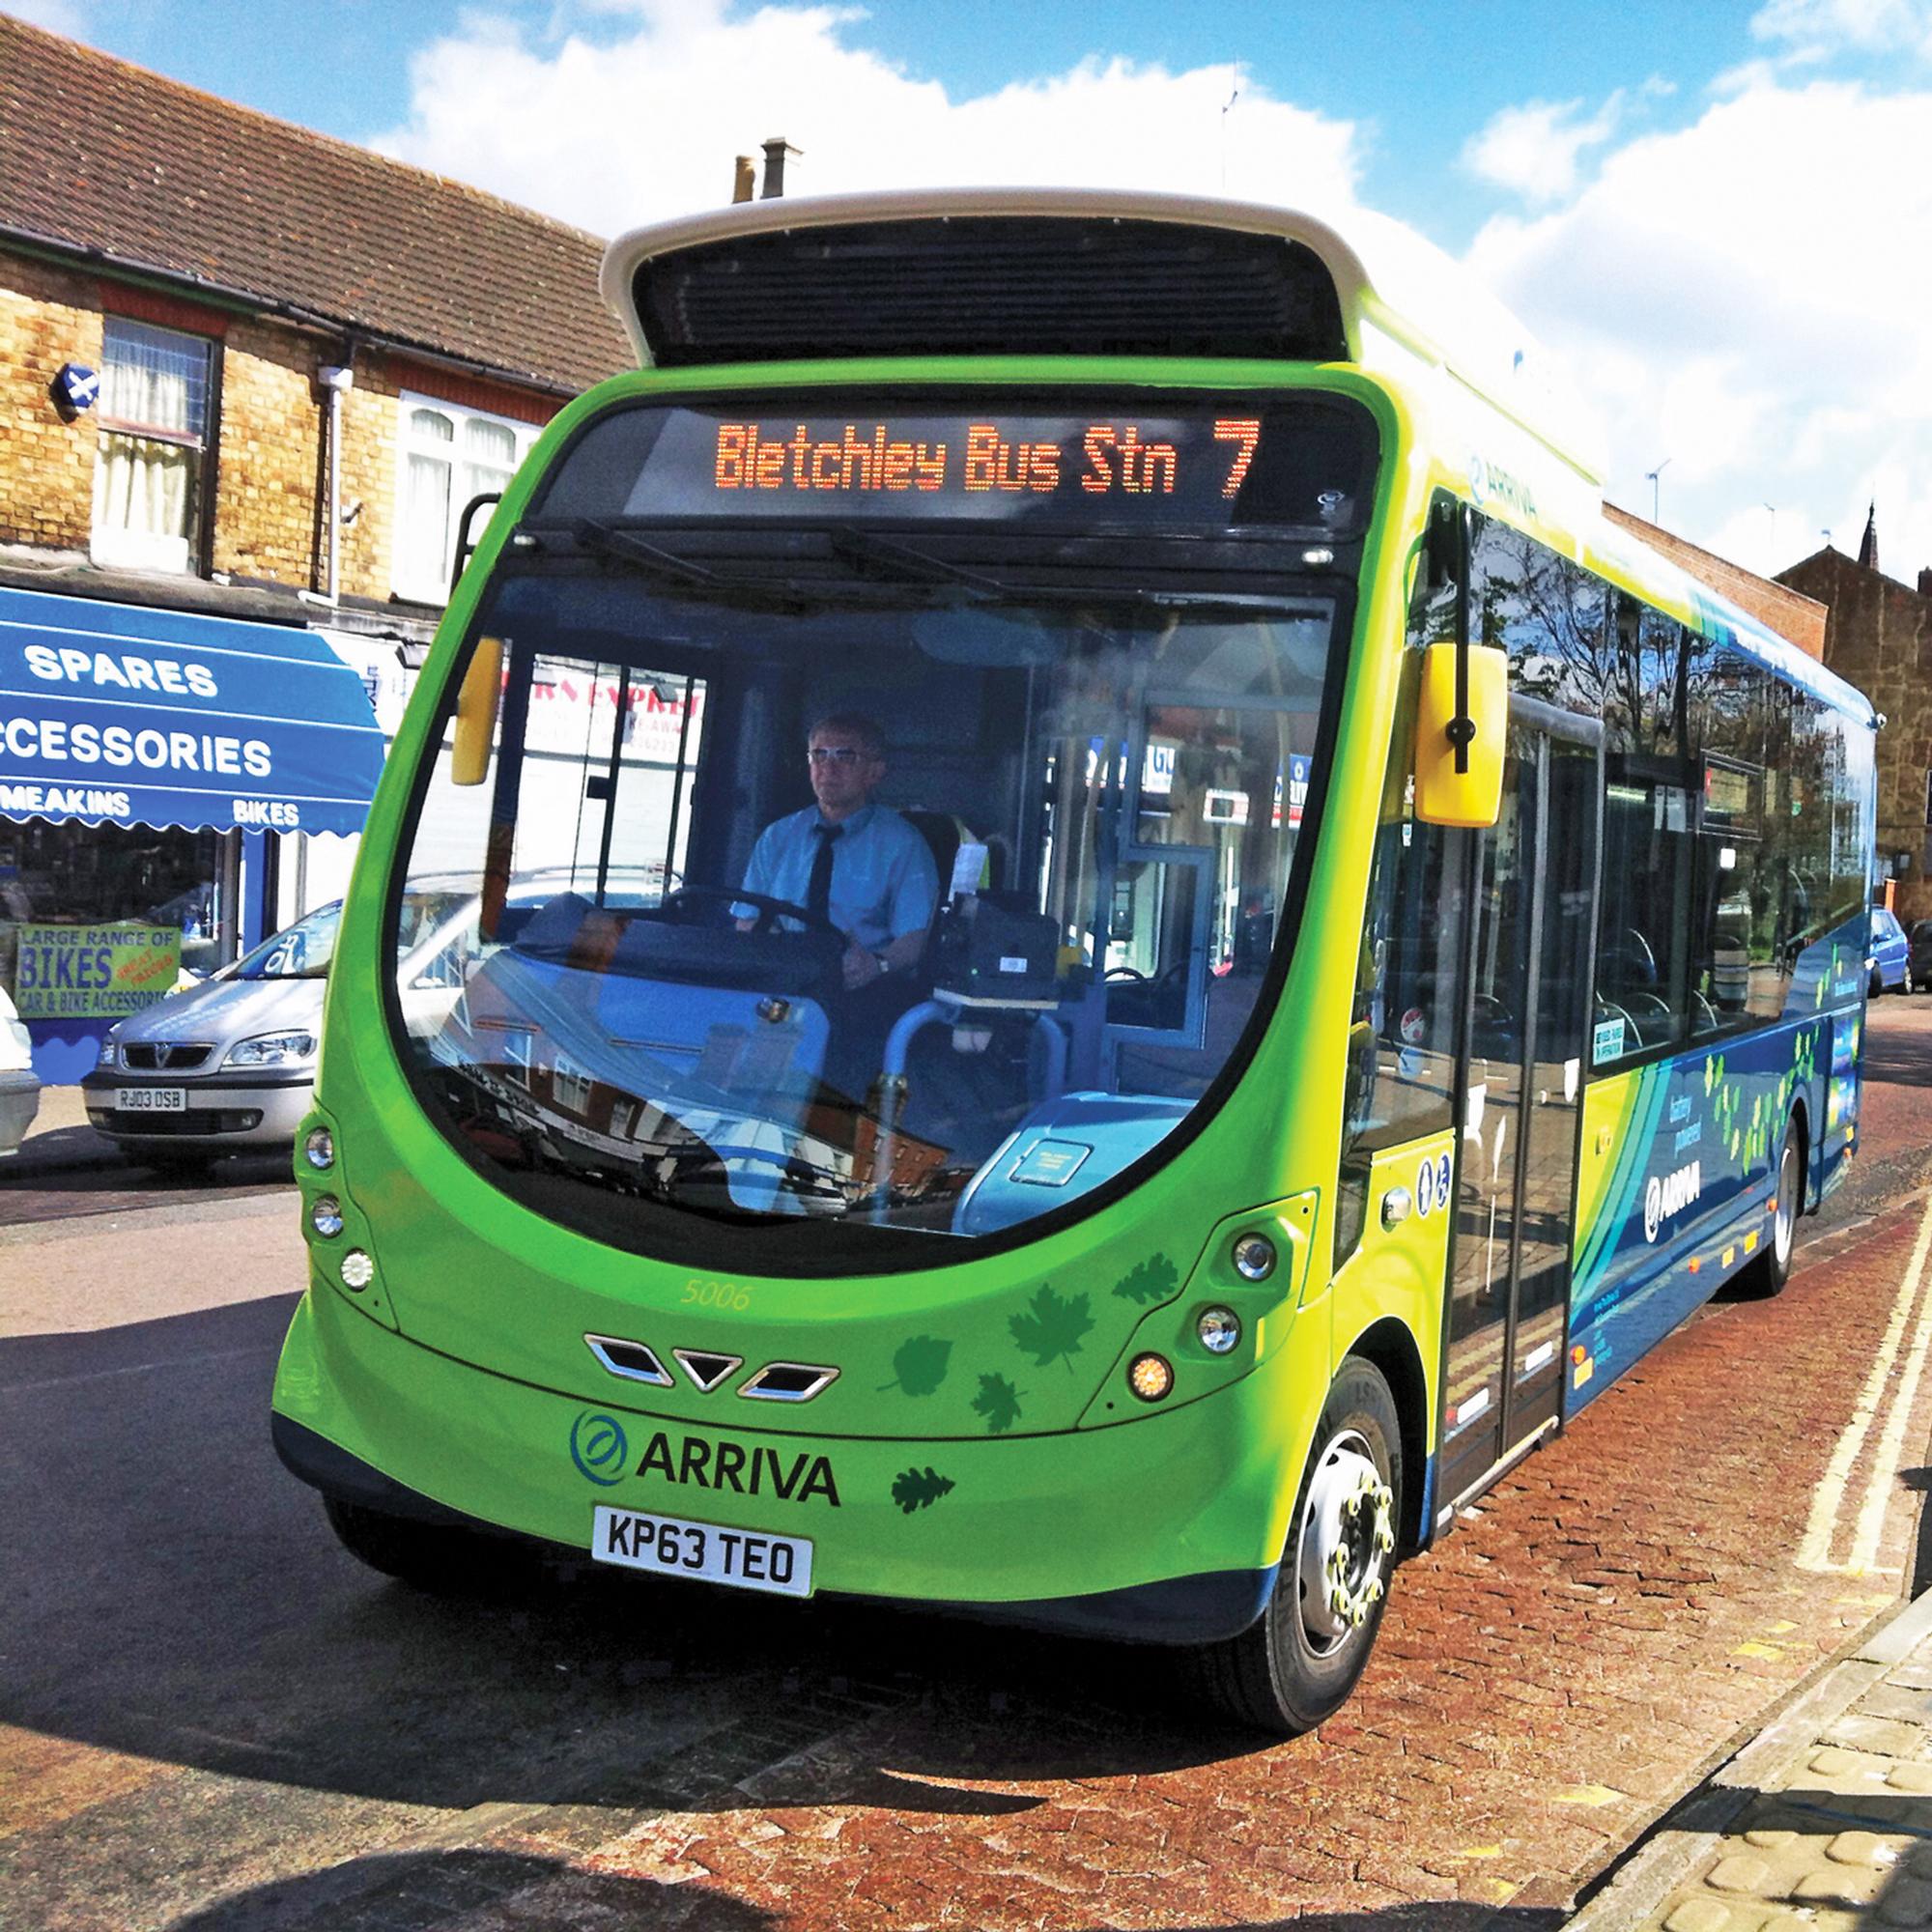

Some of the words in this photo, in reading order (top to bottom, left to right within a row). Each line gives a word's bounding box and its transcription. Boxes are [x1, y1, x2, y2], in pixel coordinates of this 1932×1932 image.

[715, 425, 946, 491] Bletchley
[964, 426, 1061, 492] Bus
[1082, 426, 1176, 494] Stn
[1213, 419, 1260, 499] 7
[24, 644, 218, 697] SPARES
[0, 717, 272, 777] CESSORIES
[233, 799, 299, 826] BIKES
[21, 930, 79, 946] LARGE
[86, 930, 145, 947] RANGE
[152, 931, 174, 947] OF
[19, 947, 112, 989] BIKES
[18, 991, 43, 1012] CAR
[60, 991, 88, 1012] BIKE
[680, 1279, 756, 1311] 5006
[636, 1432, 841, 1507] ARRIVA
[608, 1514, 706, 1569] KP63
[719, 1533, 794, 1584] TEO
